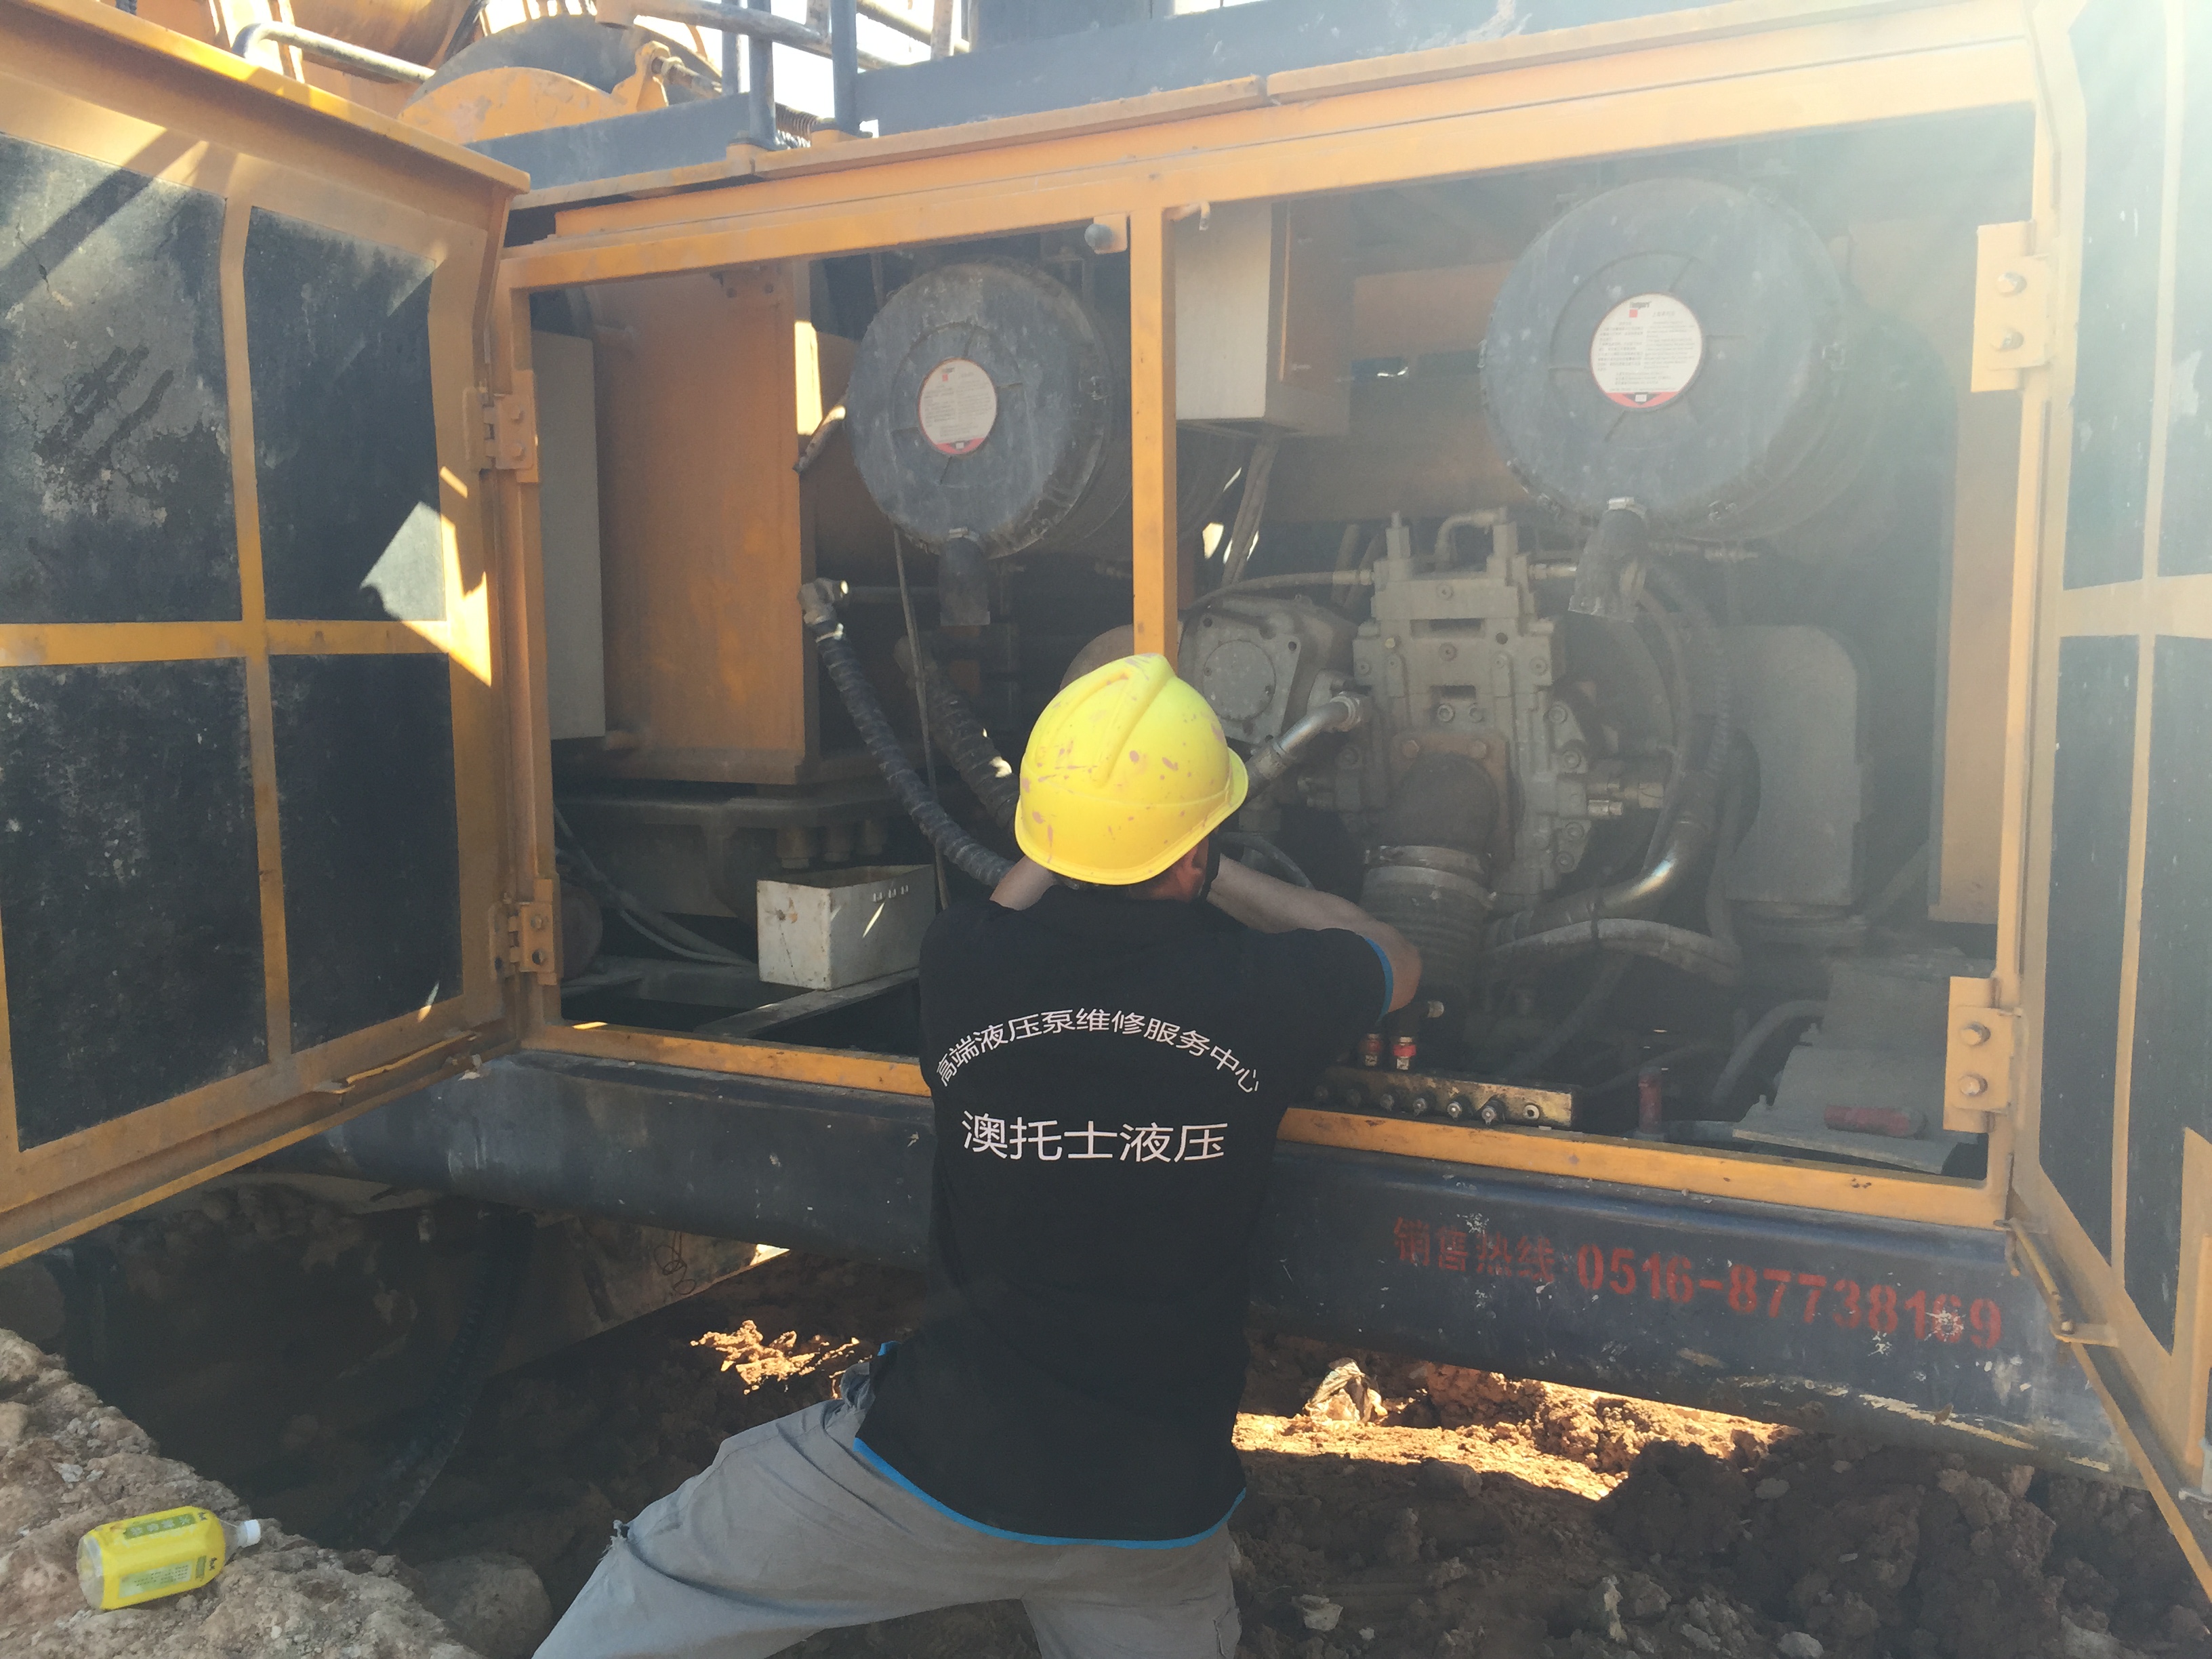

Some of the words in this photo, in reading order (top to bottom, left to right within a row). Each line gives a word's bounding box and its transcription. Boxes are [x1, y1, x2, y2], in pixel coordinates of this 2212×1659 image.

[936, 1007, 1259, 1094] 高端液压泵维修服务中心
[961, 1110, 1228, 1163] 澳托士液压
[1576, 1244, 2003, 1350] 0516-87738169
